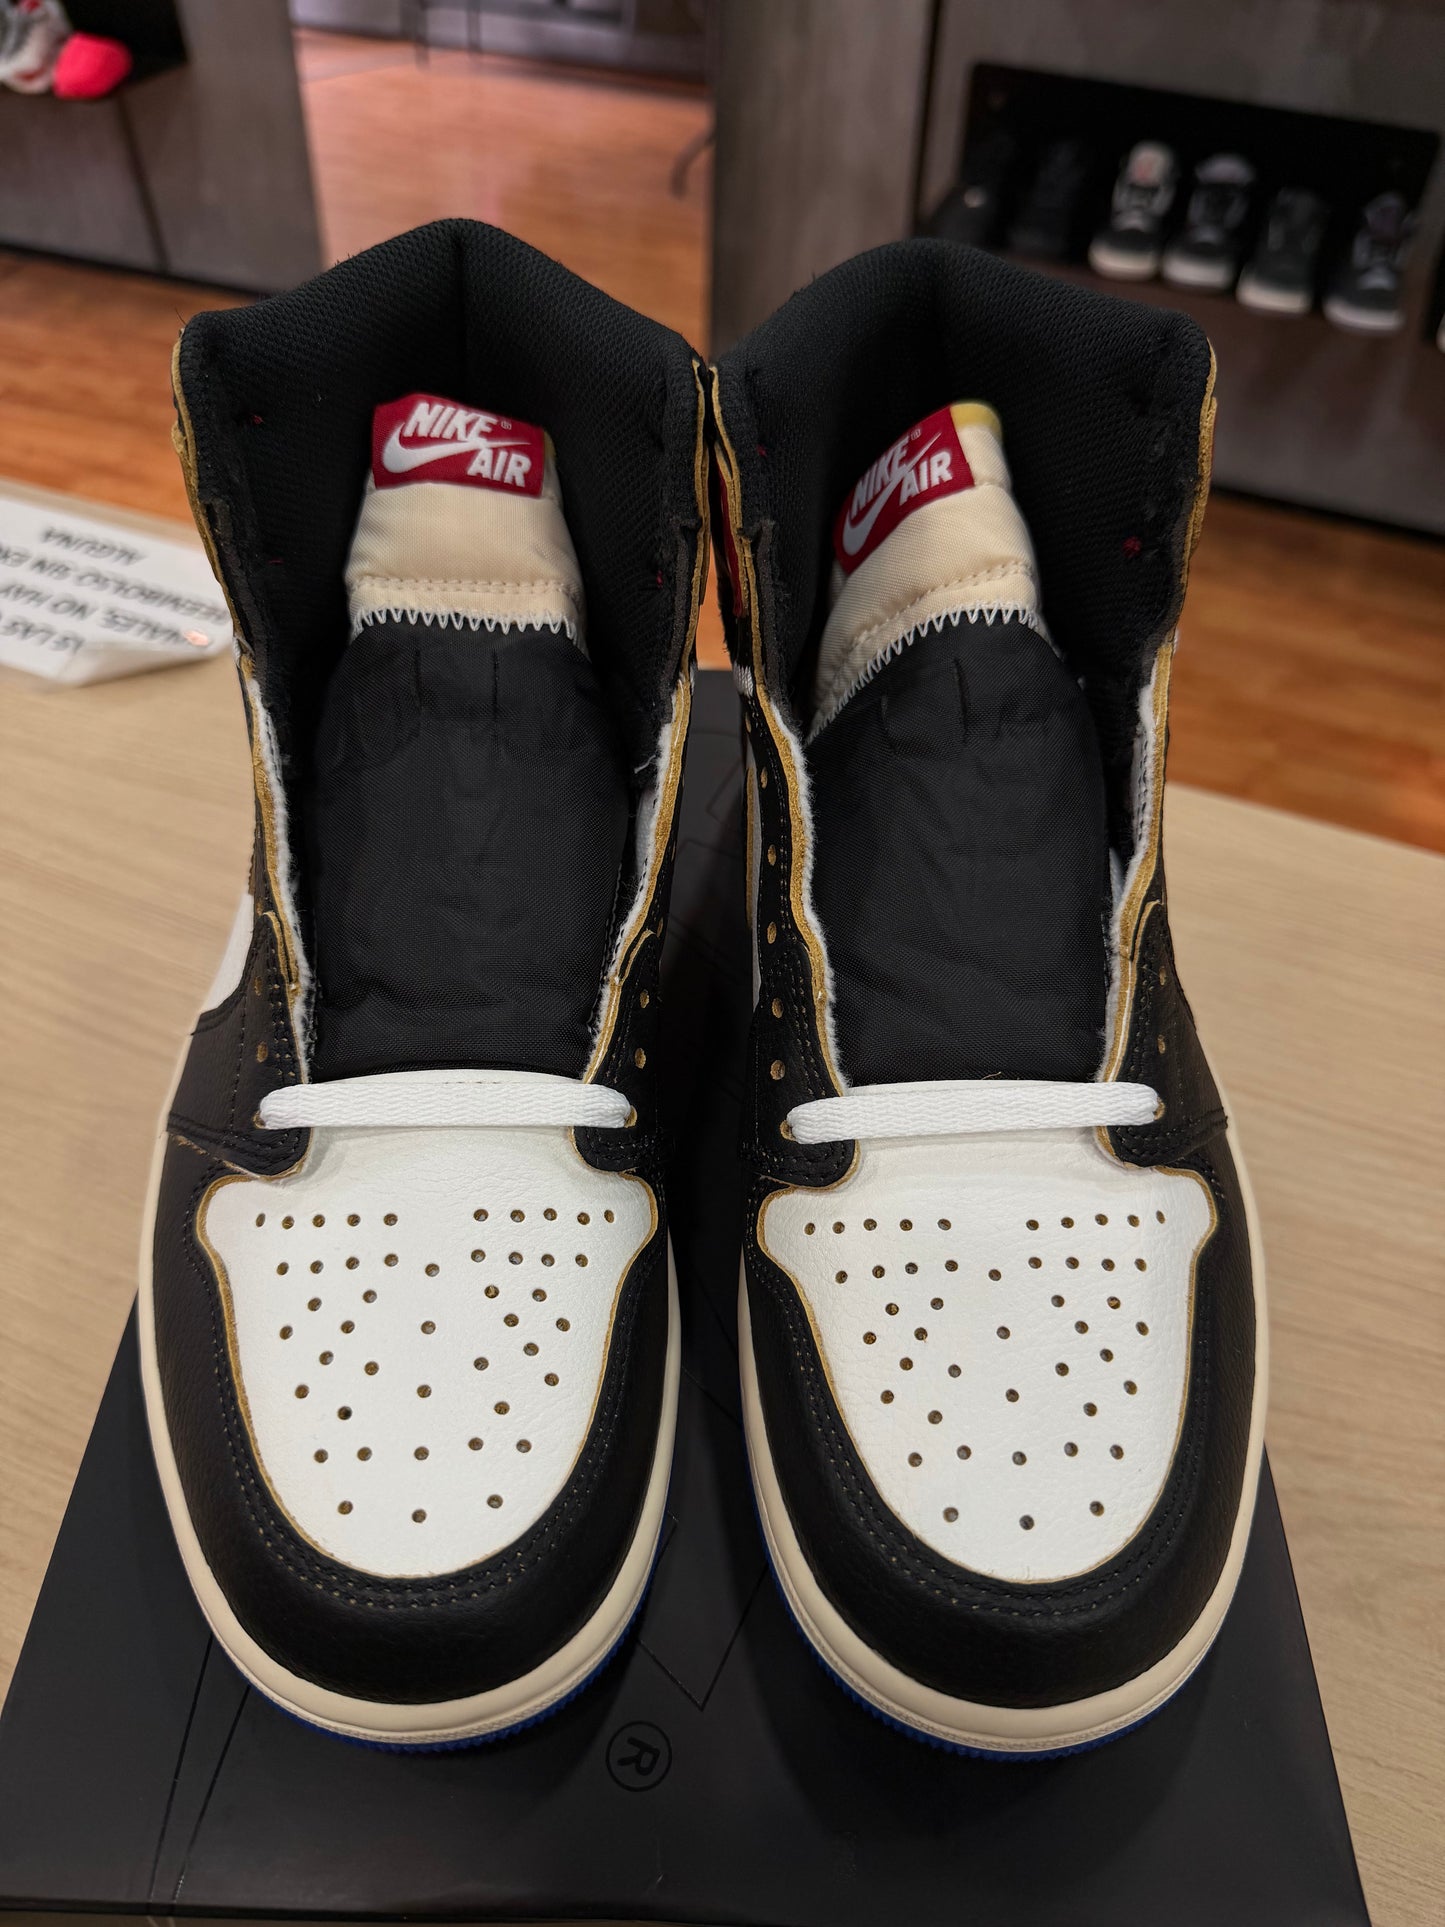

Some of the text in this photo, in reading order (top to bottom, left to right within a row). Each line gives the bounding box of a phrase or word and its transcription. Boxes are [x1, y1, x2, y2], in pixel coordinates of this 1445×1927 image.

[404, 402, 499, 442] NIKE
[467, 447, 532, 487] AIR
[850, 435, 910, 520] NIKE
[899, 451, 954, 506] AIR
[41, 526, 146, 565] ALGUNA
[49, 593, 97, 621] NO
